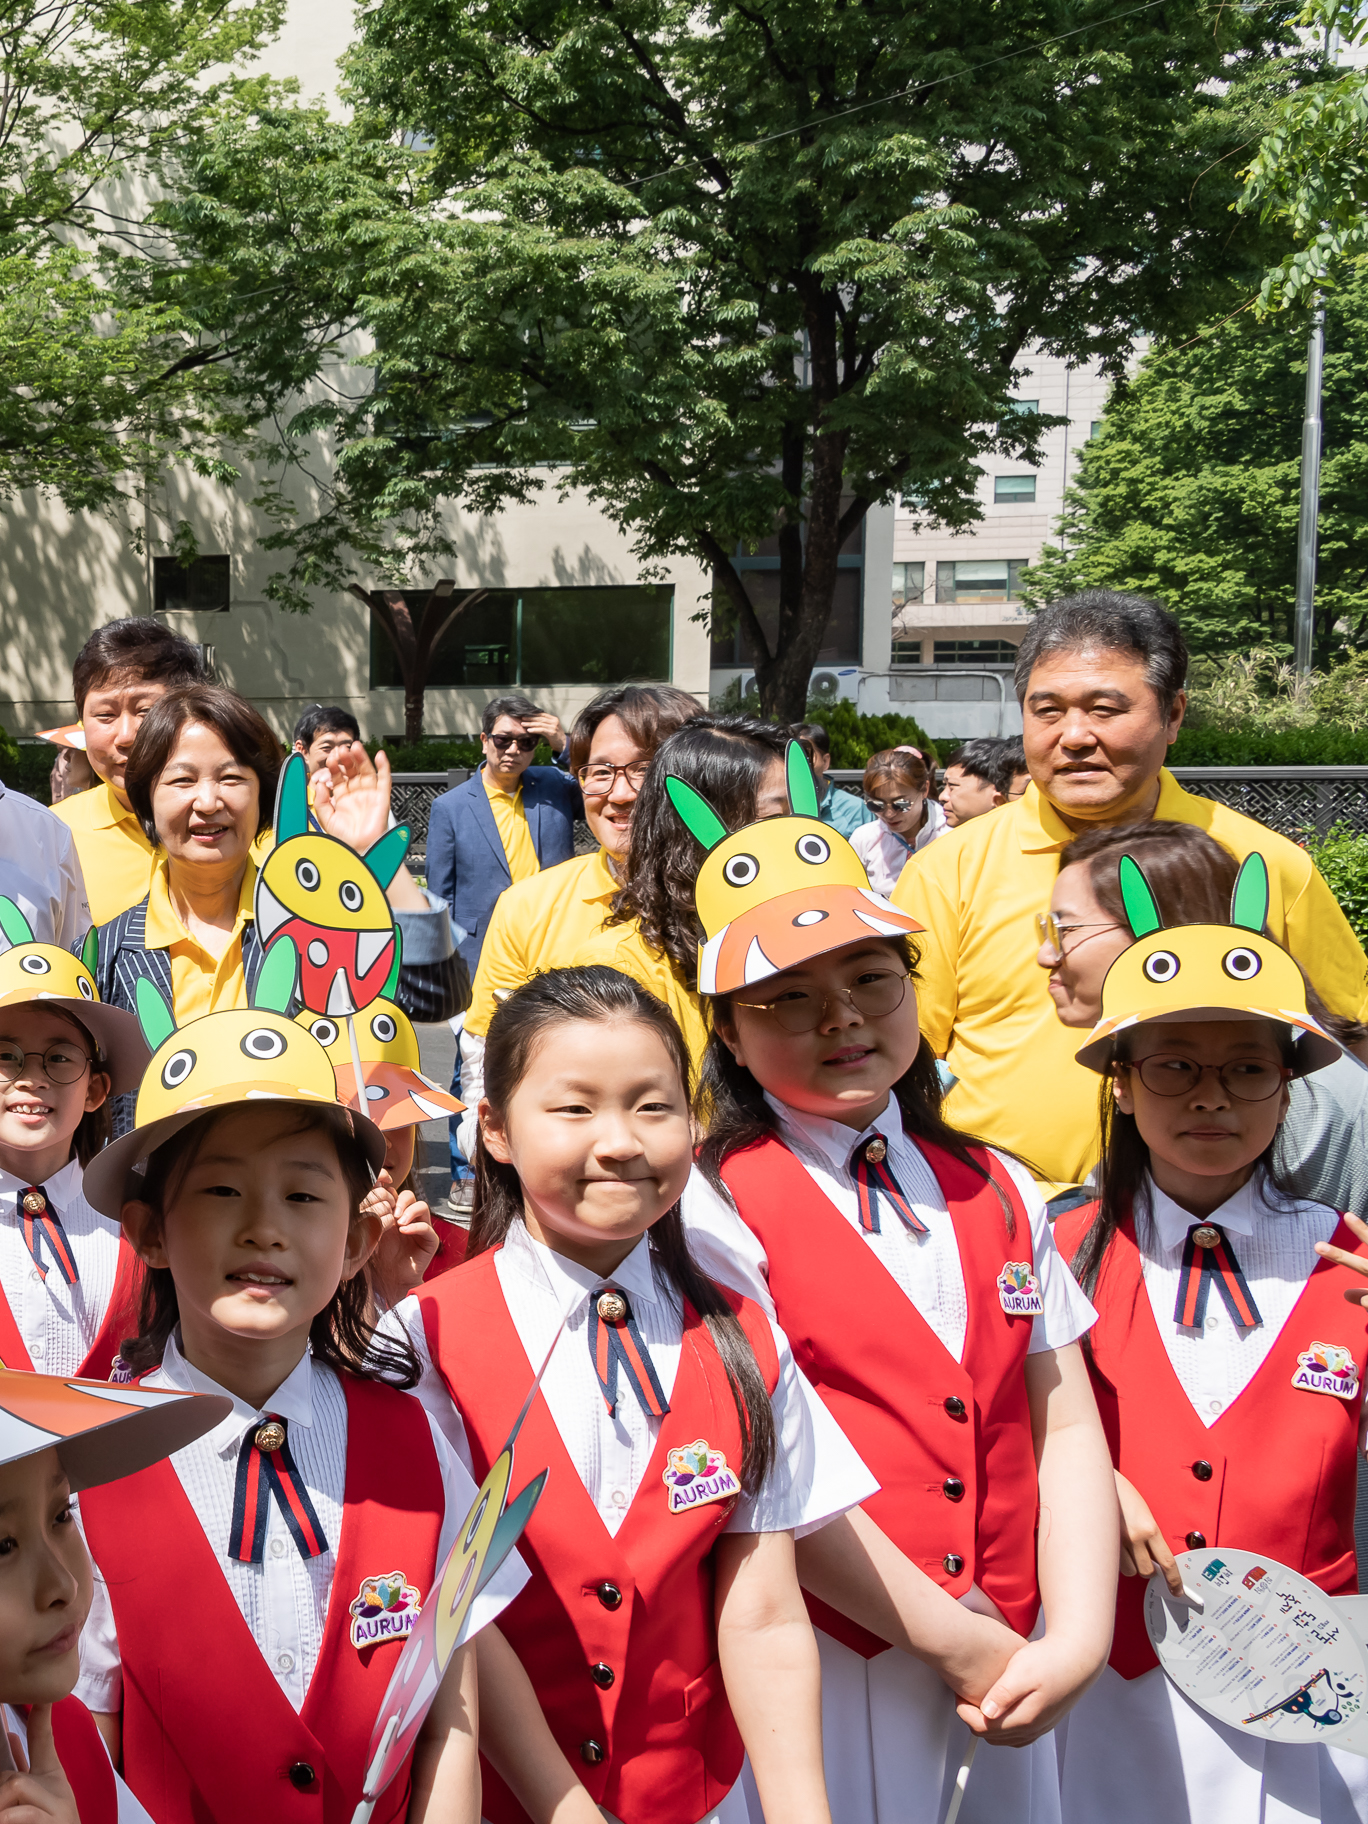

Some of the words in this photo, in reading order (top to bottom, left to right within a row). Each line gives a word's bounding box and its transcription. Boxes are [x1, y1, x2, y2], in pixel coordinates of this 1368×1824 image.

[1003, 1297, 1041, 1310] AURUM
[112, 1372, 133, 1384] AUR
[1297, 1373, 1354, 1395] AURUM
[674, 1474, 736, 1509] AURUM
[1275, 1592, 1301, 1614] 축제
[356, 1613, 419, 1642] AURUM
[1292, 1609, 1316, 1628] 동화
[1310, 1627, 1339, 1645] 서울
